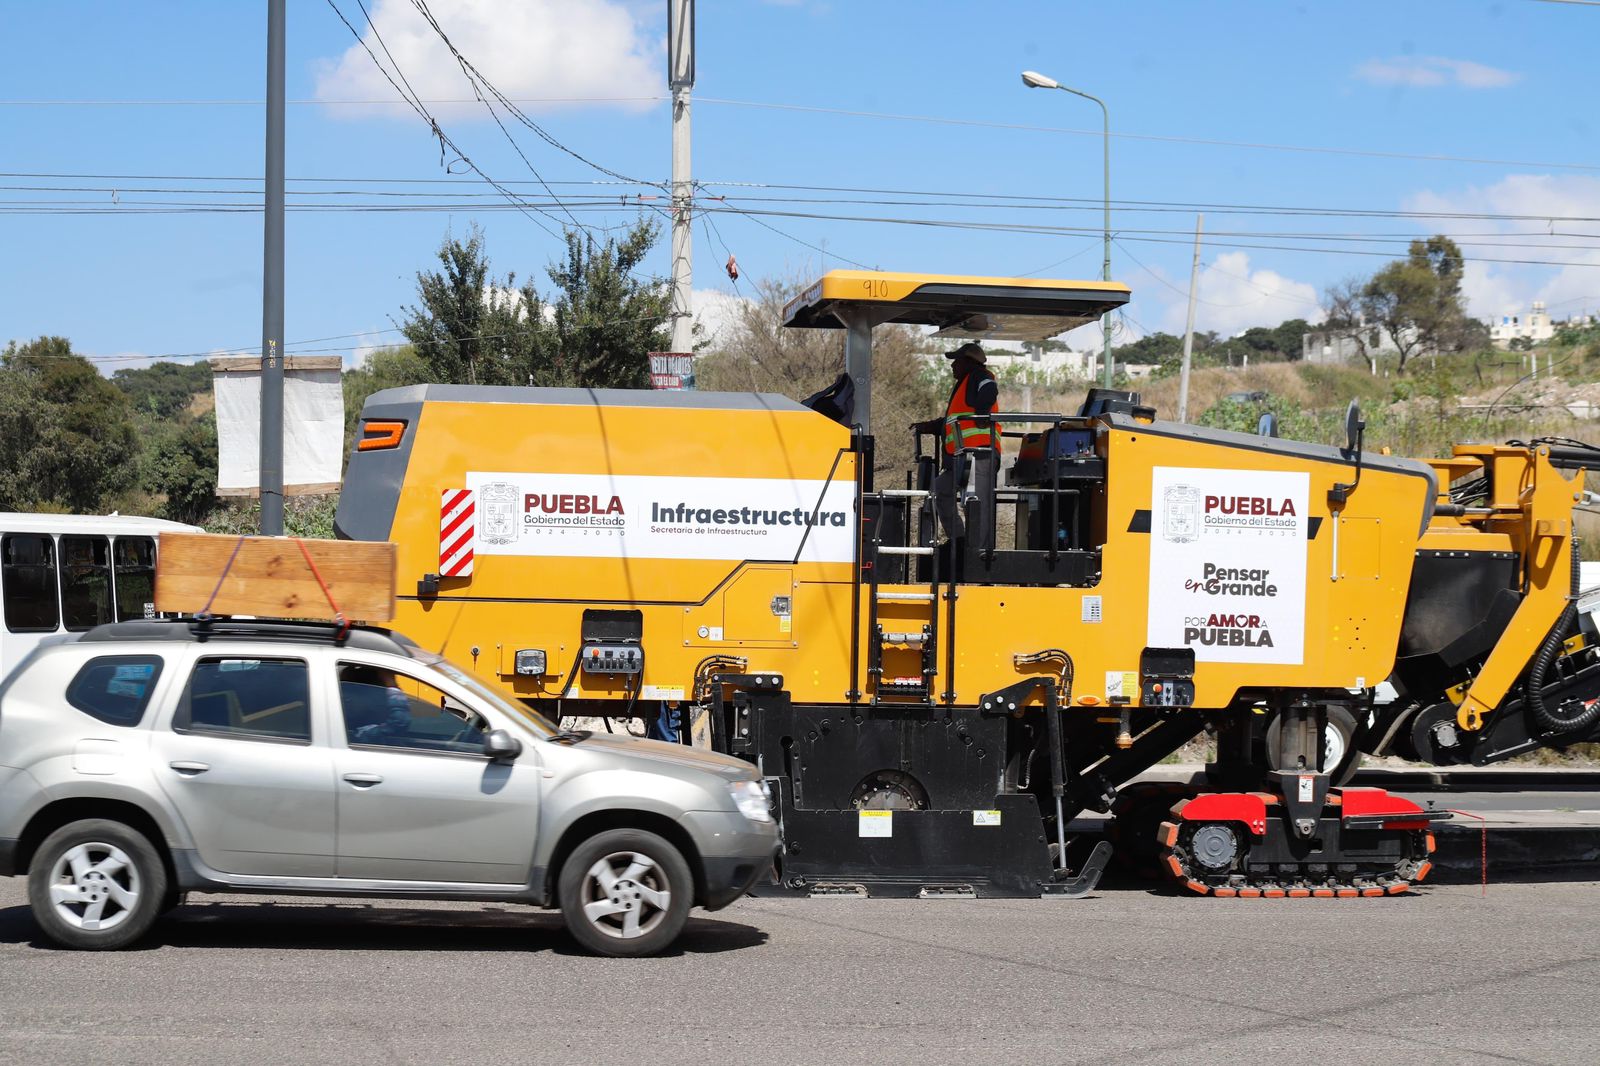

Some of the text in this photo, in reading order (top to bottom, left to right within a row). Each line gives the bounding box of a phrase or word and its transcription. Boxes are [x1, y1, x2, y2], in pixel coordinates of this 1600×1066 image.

[863, 280, 888, 297] 910
[524, 493, 625, 515] PUEBLA
[1204, 495, 1297, 517] PUEBLA
[524, 514, 625, 526] Gobierno del Estado
[651, 502, 846, 527] Infraestructura
[1204, 515, 1297, 527] Gobierno del Estado
[650, 526, 768, 536] Secretaria de Infraestructura
[1203, 562, 1270, 581] Pensar
[1185, 578, 1278, 597] en Grande
[1184, 614, 1268, 628] POR AMOR A
[1184, 627, 1274, 647] PUEBLA
